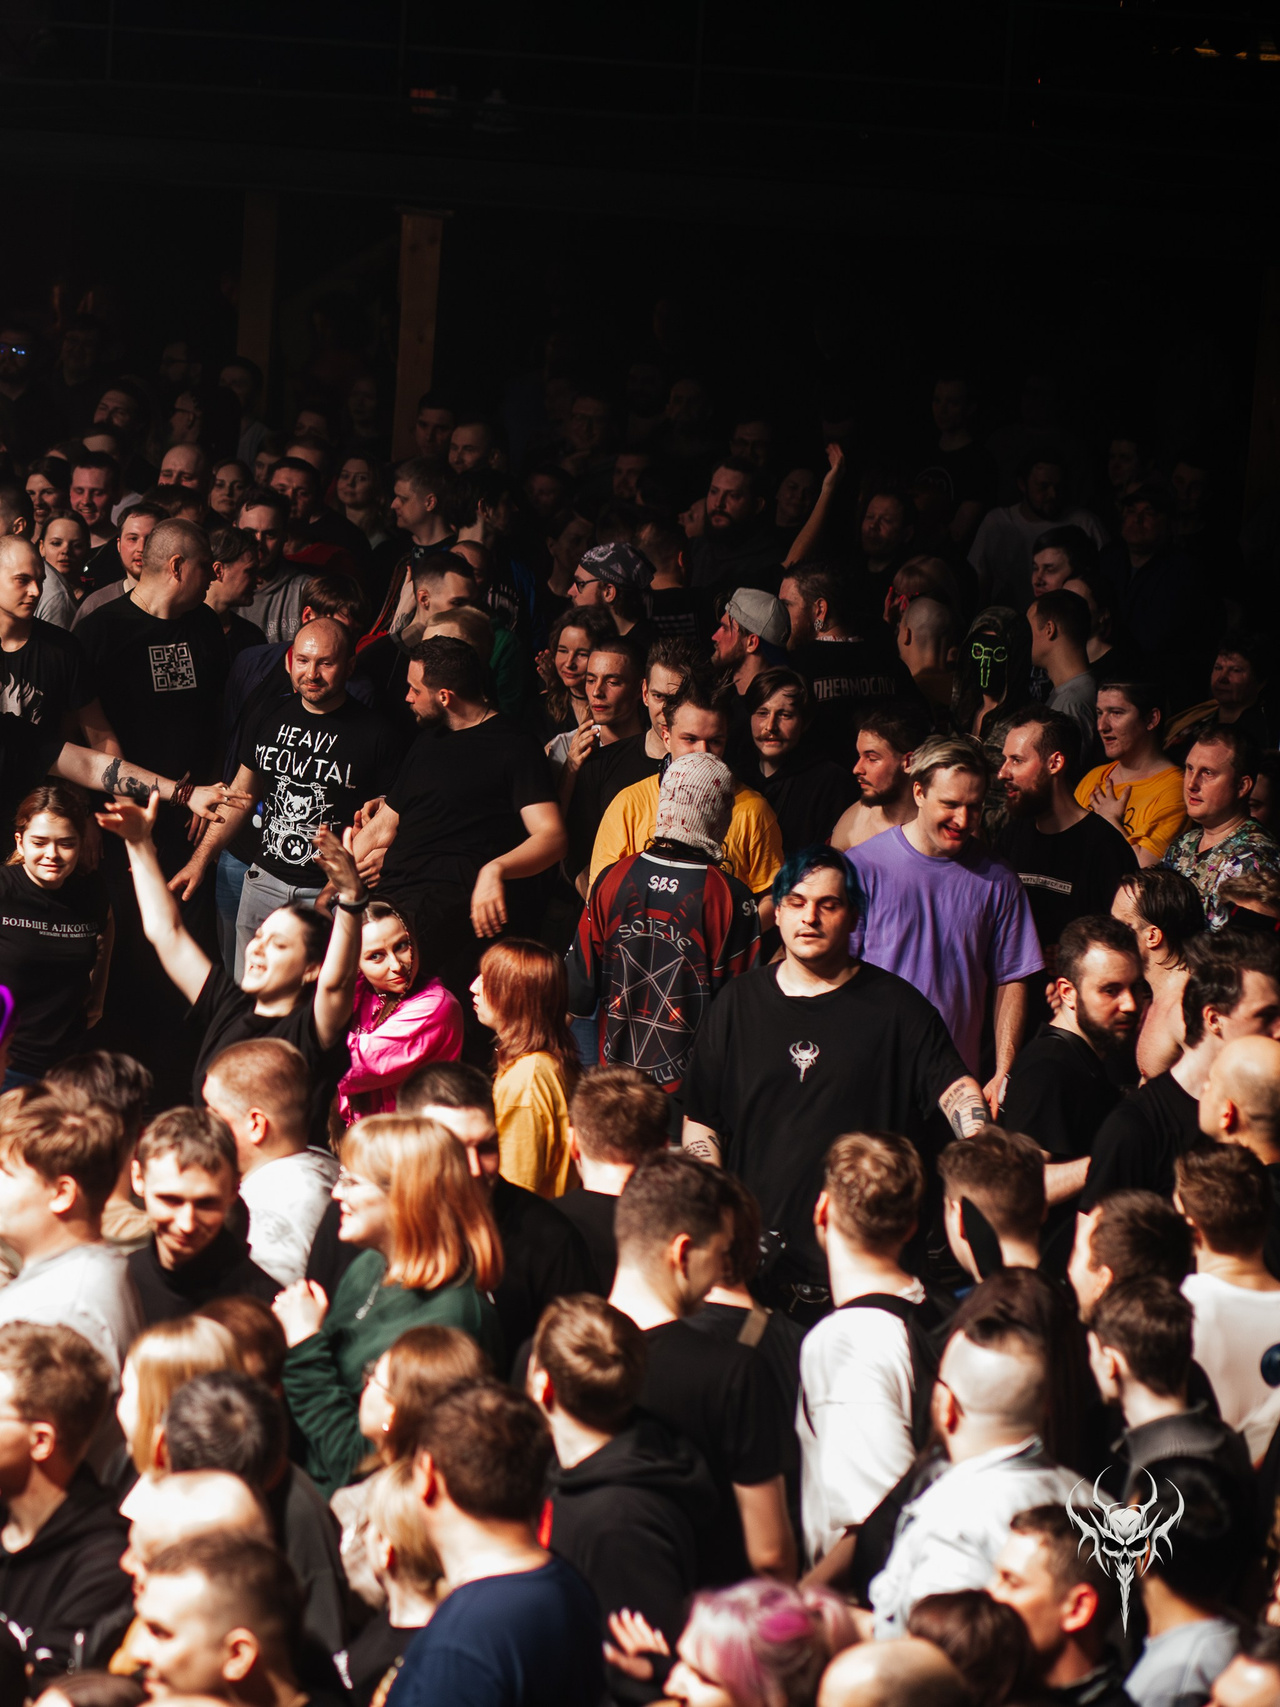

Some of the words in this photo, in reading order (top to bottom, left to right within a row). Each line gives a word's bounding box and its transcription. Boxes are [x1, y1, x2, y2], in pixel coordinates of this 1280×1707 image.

[276, 723, 338, 753] HEAVY
[255, 743, 356, 789] MEOWTAL
[647, 875, 680, 894] SBS
[1, 916, 49, 931] БОЛЬШЕ
